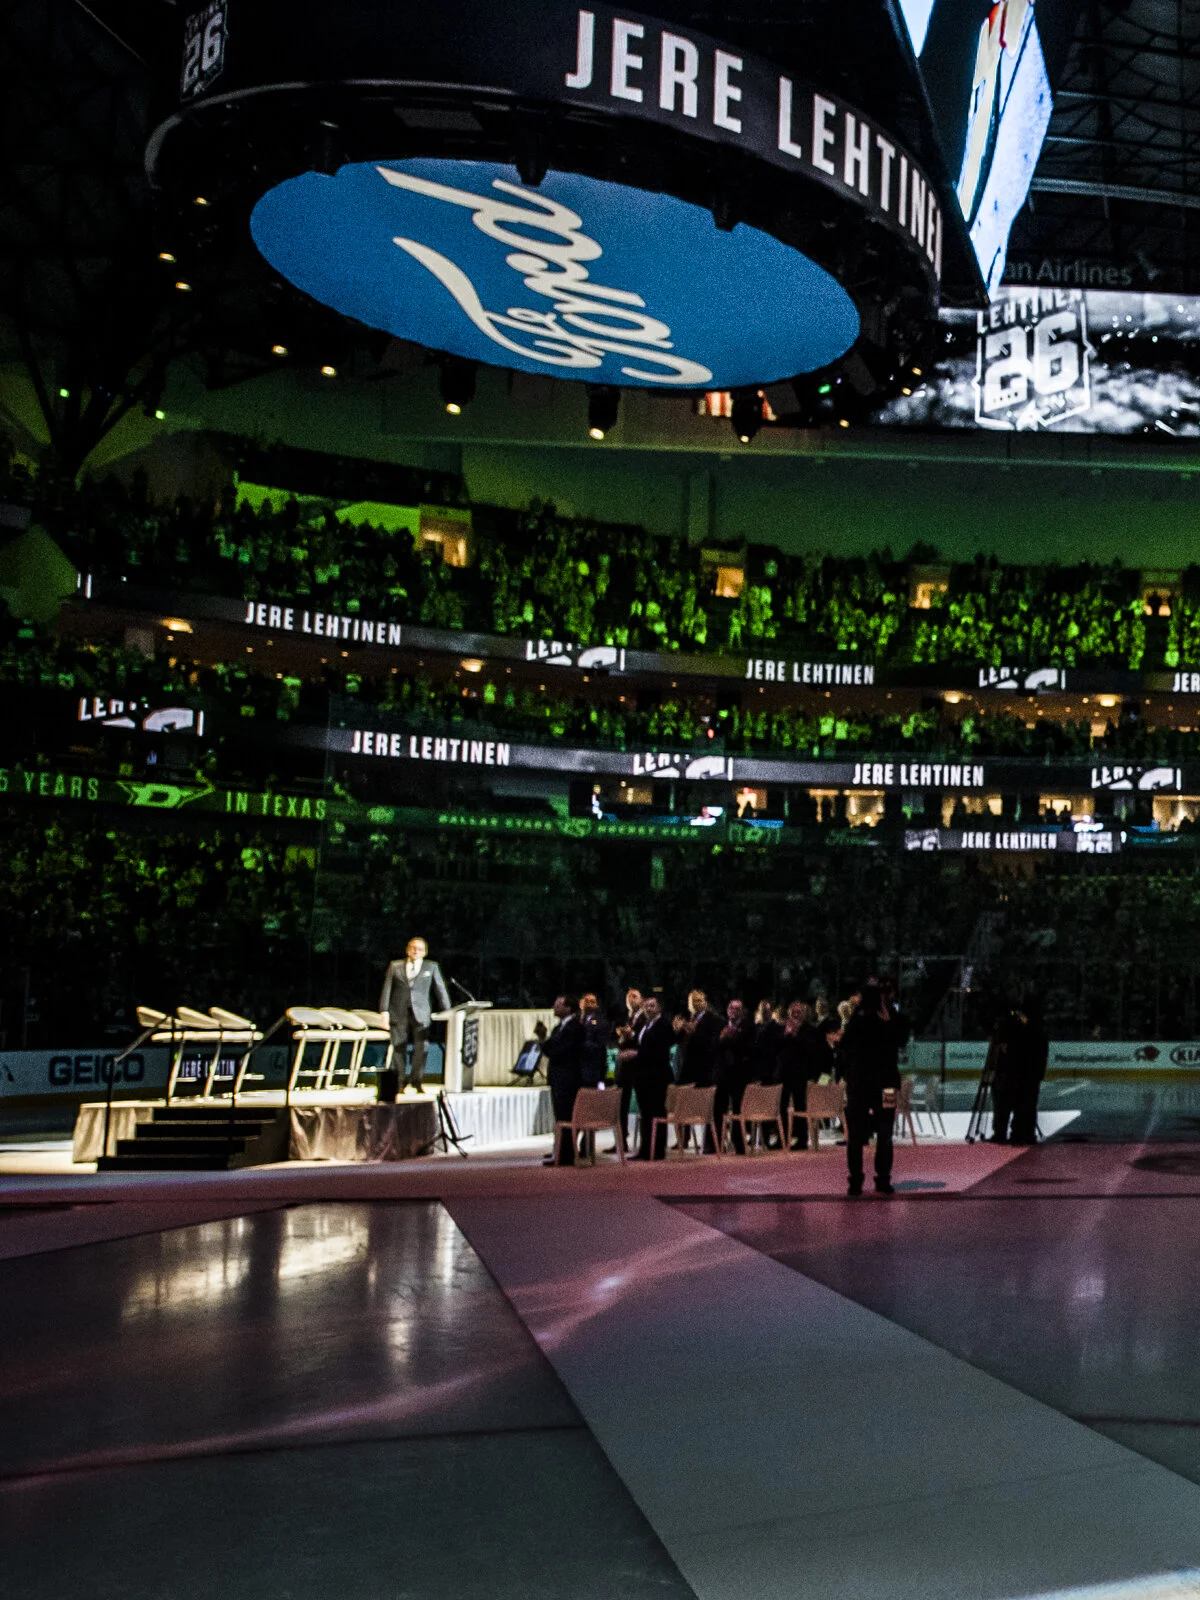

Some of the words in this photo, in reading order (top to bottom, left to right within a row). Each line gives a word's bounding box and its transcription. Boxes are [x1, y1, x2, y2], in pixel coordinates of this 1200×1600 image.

[182, 11, 223, 95] 26
[565, 9, 743, 134] JERE
[376, 165, 713, 386] Ford
[1036, 257, 1132, 286] Airlines
[983, 310, 1080, 413] 26
[245, 601, 294, 631] JERE
[302, 611, 401, 646] LEHTINEN
[745, 659, 786, 682] JERE
[793, 662, 874, 685] LEHTINEN
[350, 730, 401, 757] JERE
[409, 735, 511, 766] LEHTINEN
[24, 771, 99, 800] YEARS
[852, 763, 894, 785] JERE
[900, 764, 984, 787] LEHTINEN
[225, 789, 249, 814] IN
[261, 792, 327, 821] TEXAS
[961, 831, 991, 849] JERE
[995, 832, 1057, 850] LEHTINEN
[50, 1053, 144, 1086] GEICO
